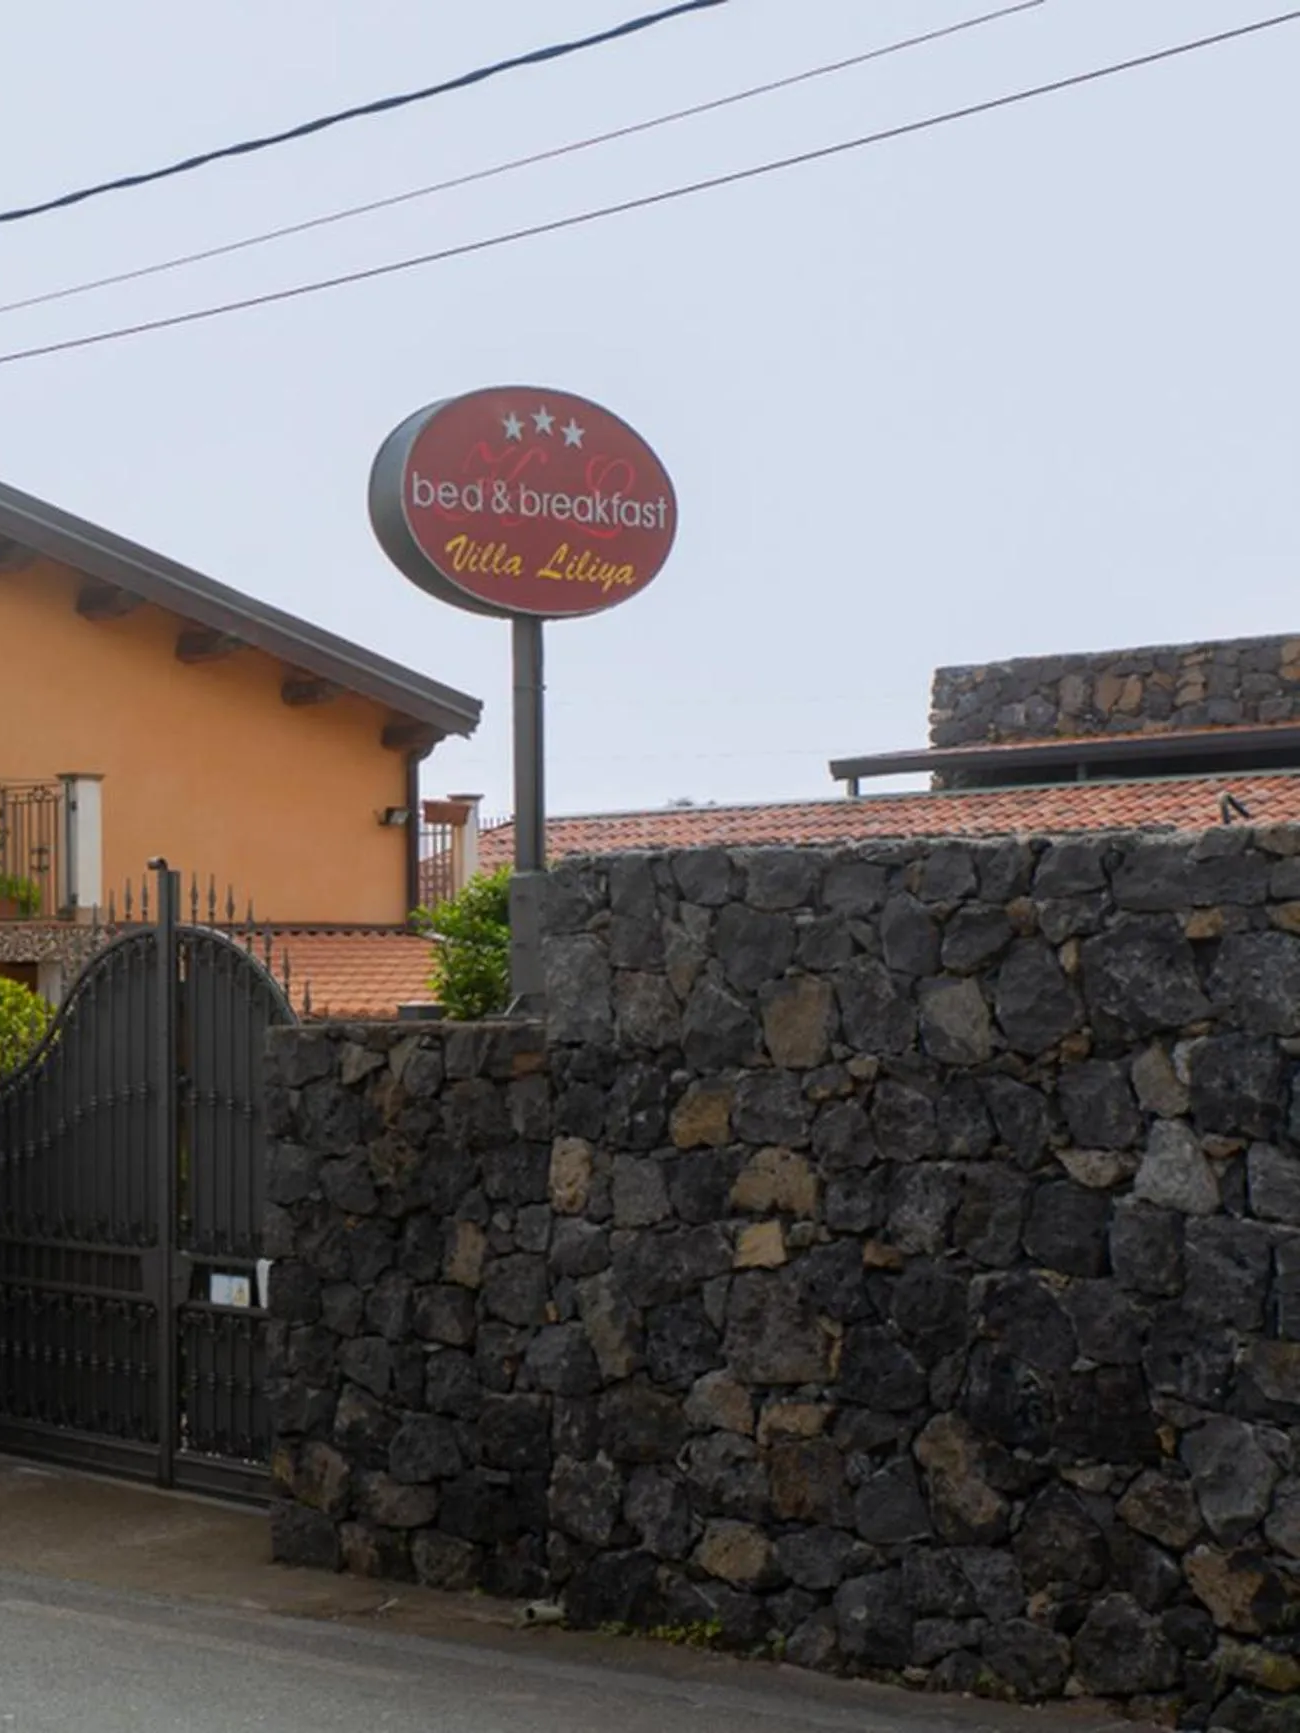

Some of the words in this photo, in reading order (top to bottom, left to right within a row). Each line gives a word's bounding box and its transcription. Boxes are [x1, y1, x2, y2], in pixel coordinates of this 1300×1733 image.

[412, 471, 484, 513] bed
[491, 479, 515, 514] &
[520, 483, 667, 529] breakfast
[445, 534, 524, 576] Villa
[537, 543, 636, 591] Liliya
